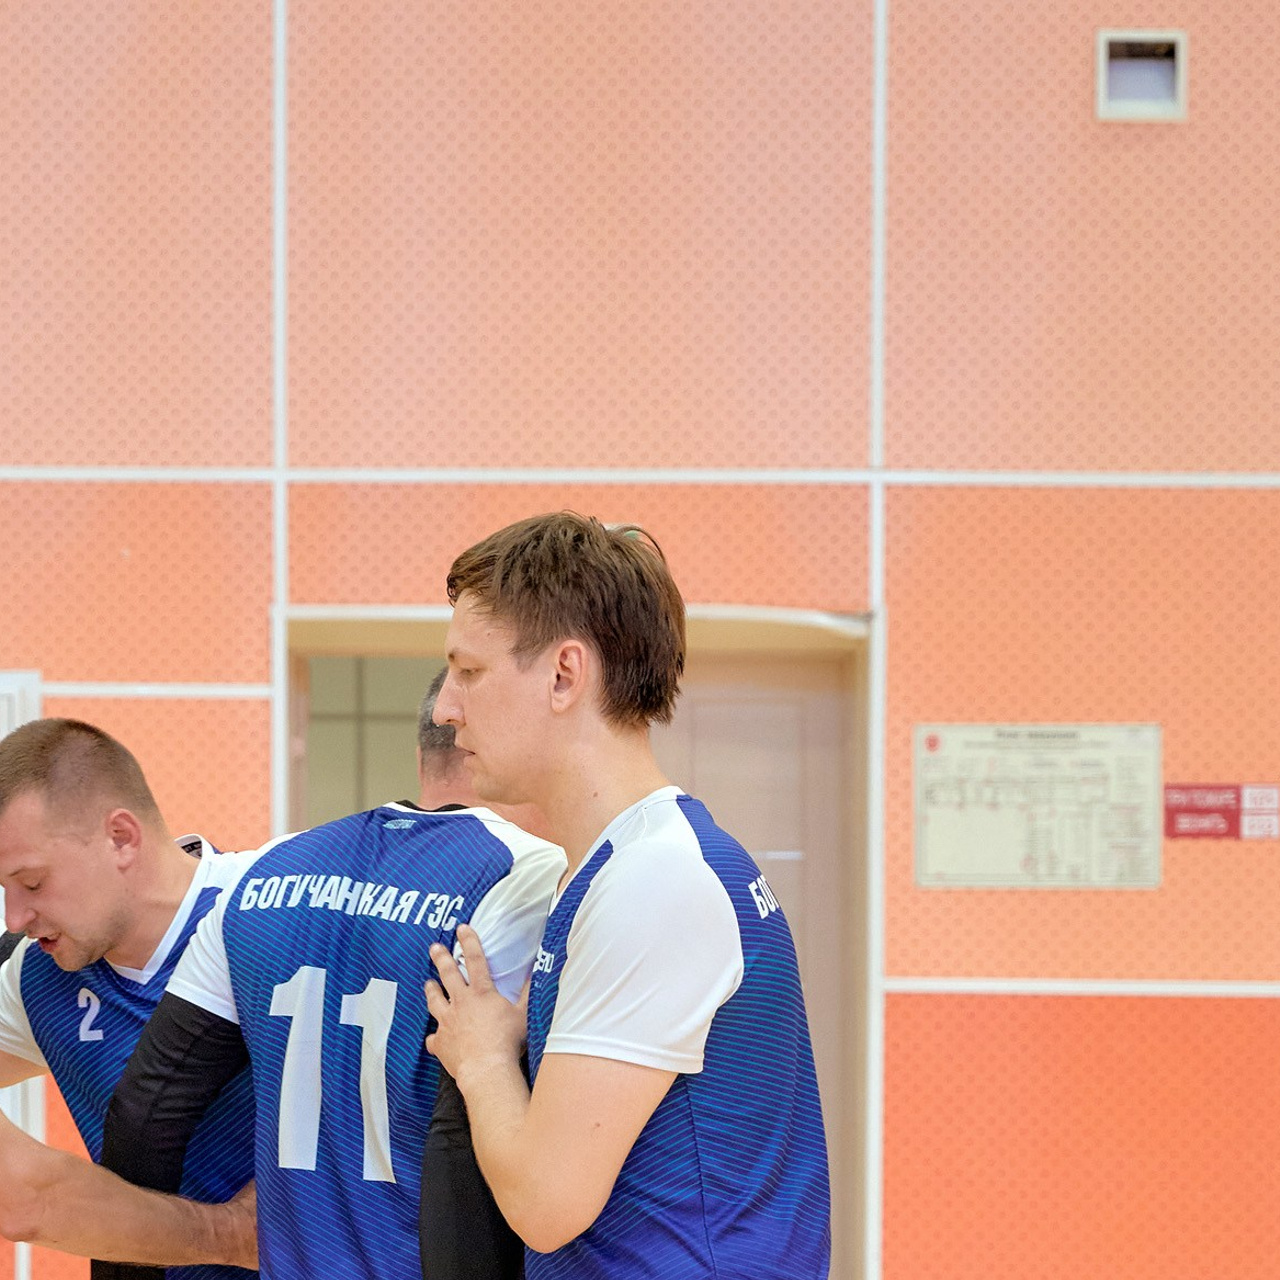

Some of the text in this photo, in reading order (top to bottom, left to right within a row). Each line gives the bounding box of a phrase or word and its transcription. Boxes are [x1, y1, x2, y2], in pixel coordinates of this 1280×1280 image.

[414, 893, 464, 931] ГЭС
[77, 987, 103, 1041] 2
[268, 965, 398, 1184] 11
